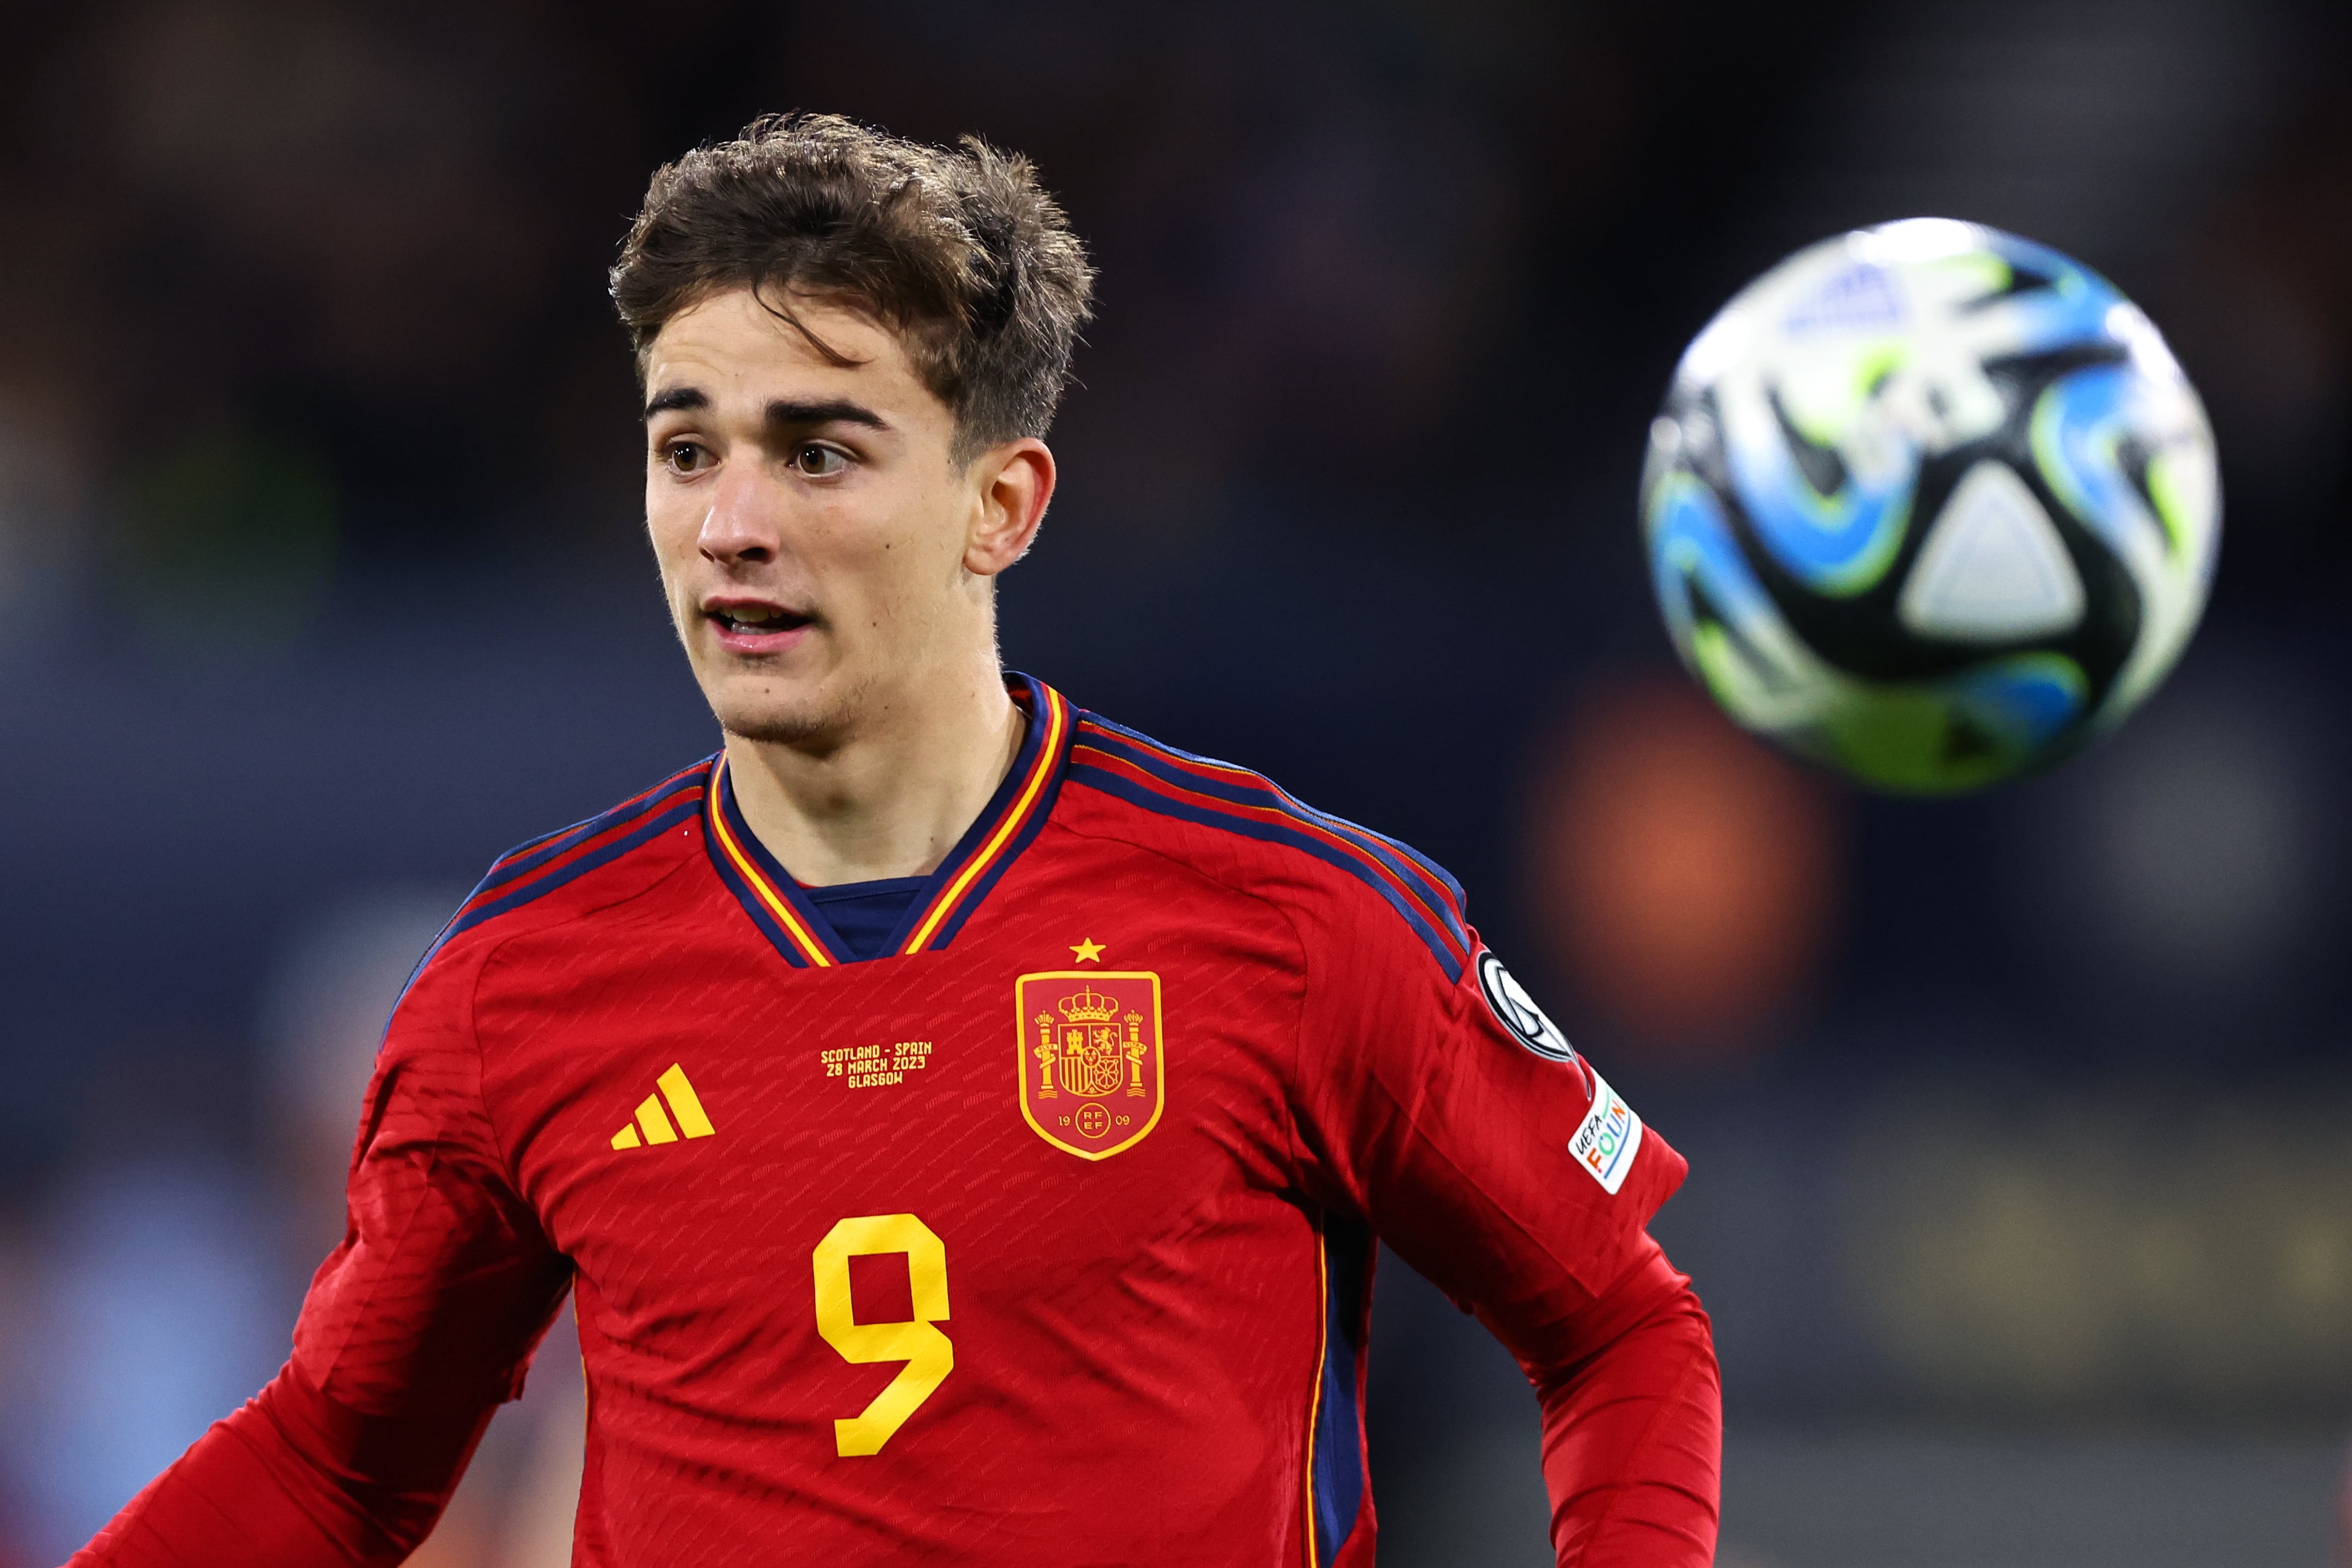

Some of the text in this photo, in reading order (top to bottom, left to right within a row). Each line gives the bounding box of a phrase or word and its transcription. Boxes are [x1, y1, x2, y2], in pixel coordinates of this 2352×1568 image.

[821, 1045, 880, 1063] SCOTLAND
[895, 1041, 932, 1056] SPAIN
[826, 1055, 925, 1077] 28 MARCH 2023
[848, 1071, 903, 1089] GLASGOW
[1058, 1115, 1070, 1126] 19
[1115, 1115, 1130, 1125] 09
[1575, 1114, 1603, 1155] UEFA
[1587, 1099, 1626, 1173] FOUN
[812, 1213, 954, 1457] 9
